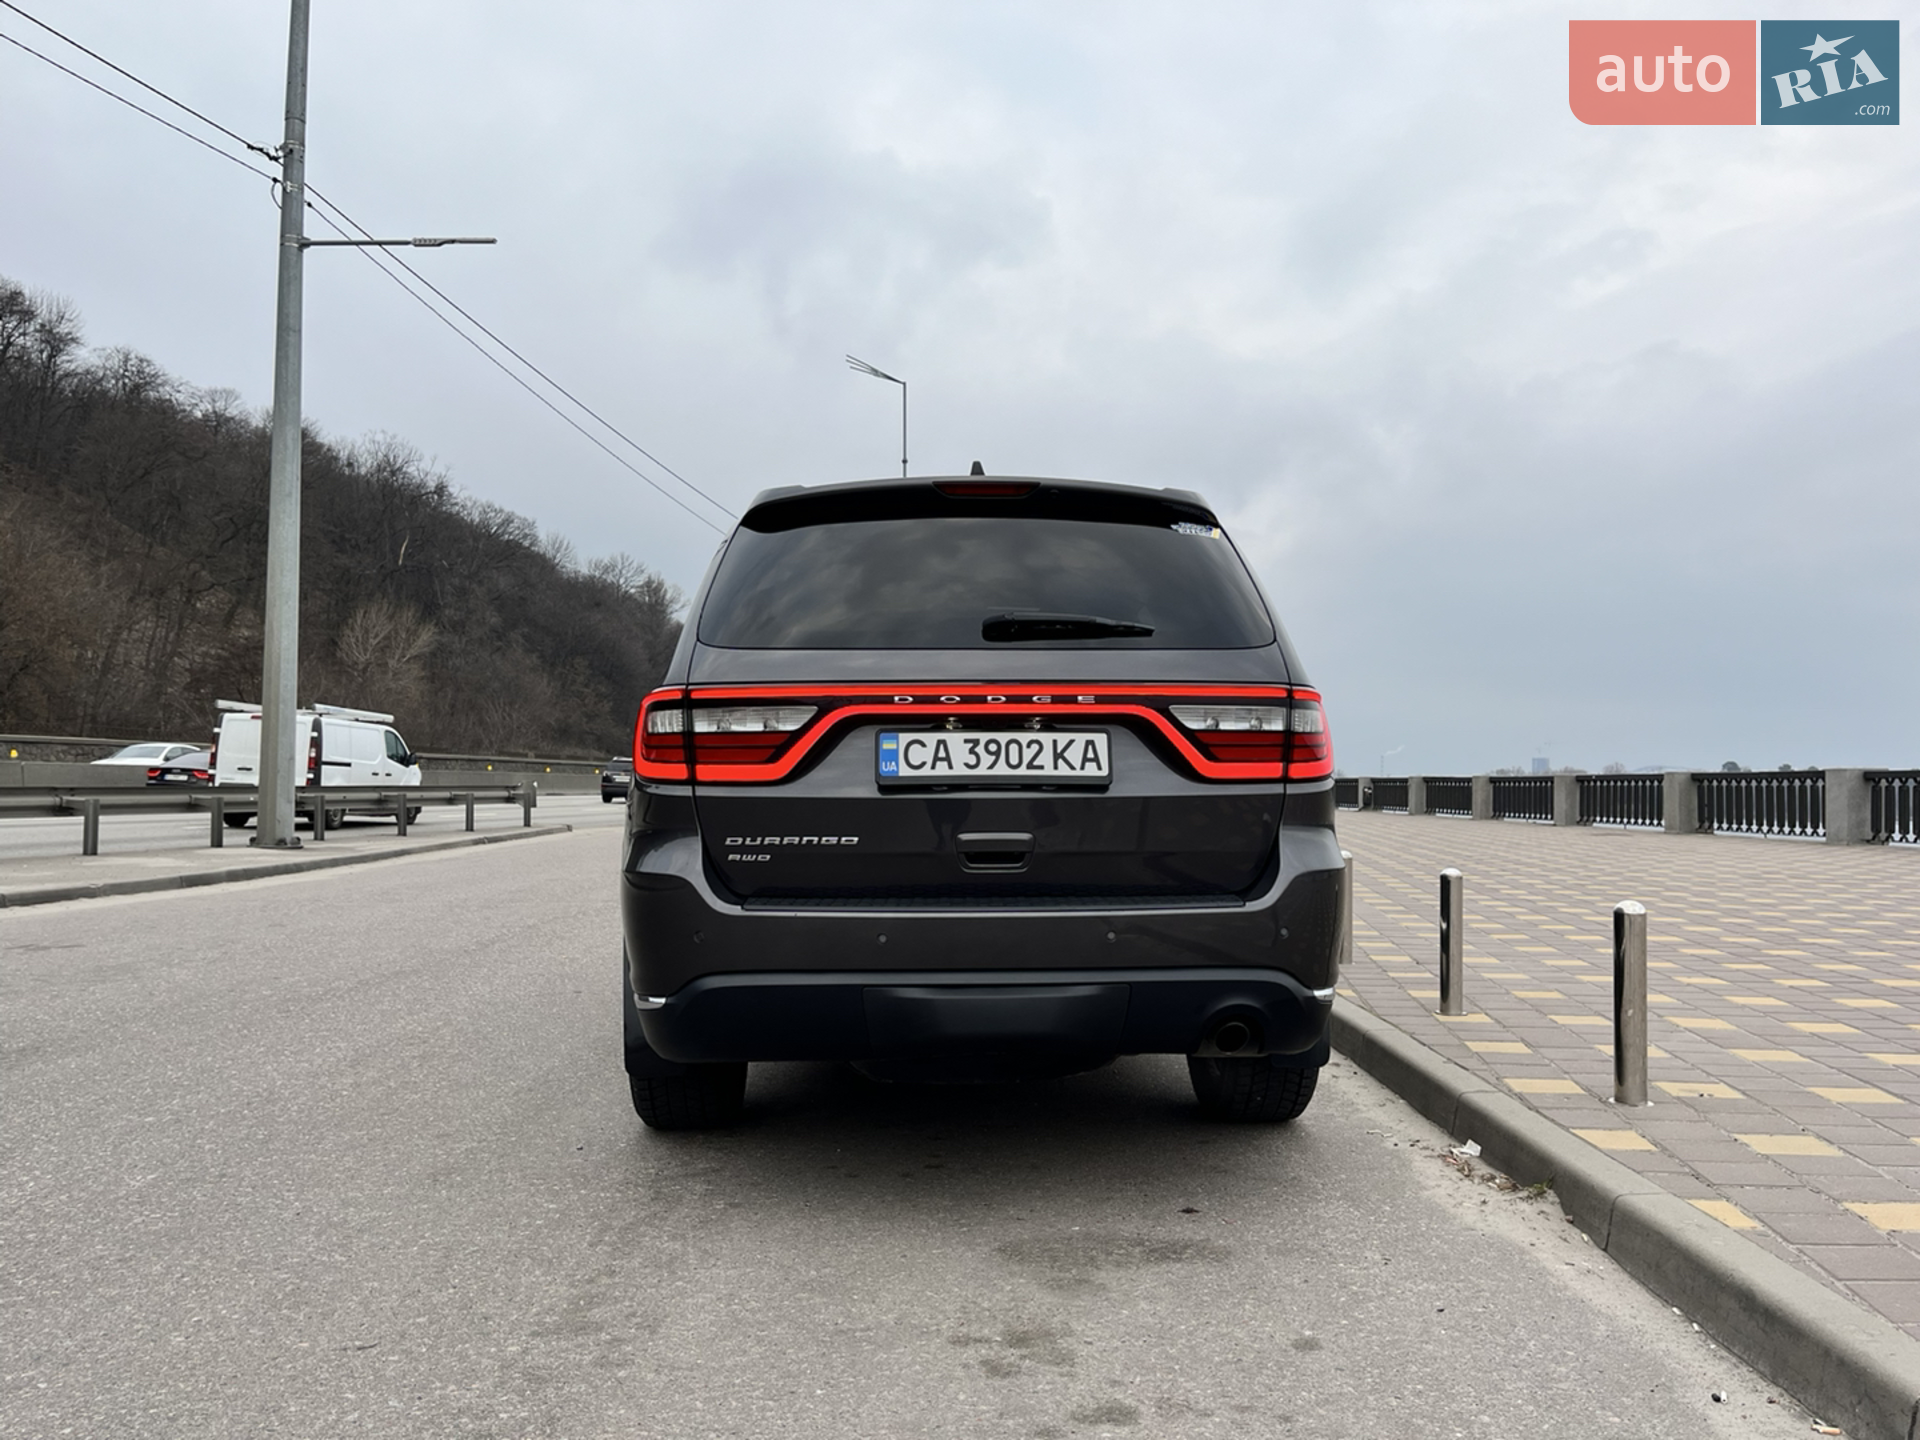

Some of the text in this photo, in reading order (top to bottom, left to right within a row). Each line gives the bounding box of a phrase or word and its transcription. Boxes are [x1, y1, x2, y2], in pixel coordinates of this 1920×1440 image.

[893, 695, 1096, 704] DODGE
[903, 738, 1103, 771] CA 3902 KA
[882, 762, 898, 772] UA
[724, 836, 860, 846] DURANGO
[727, 853, 772, 862] AWD
